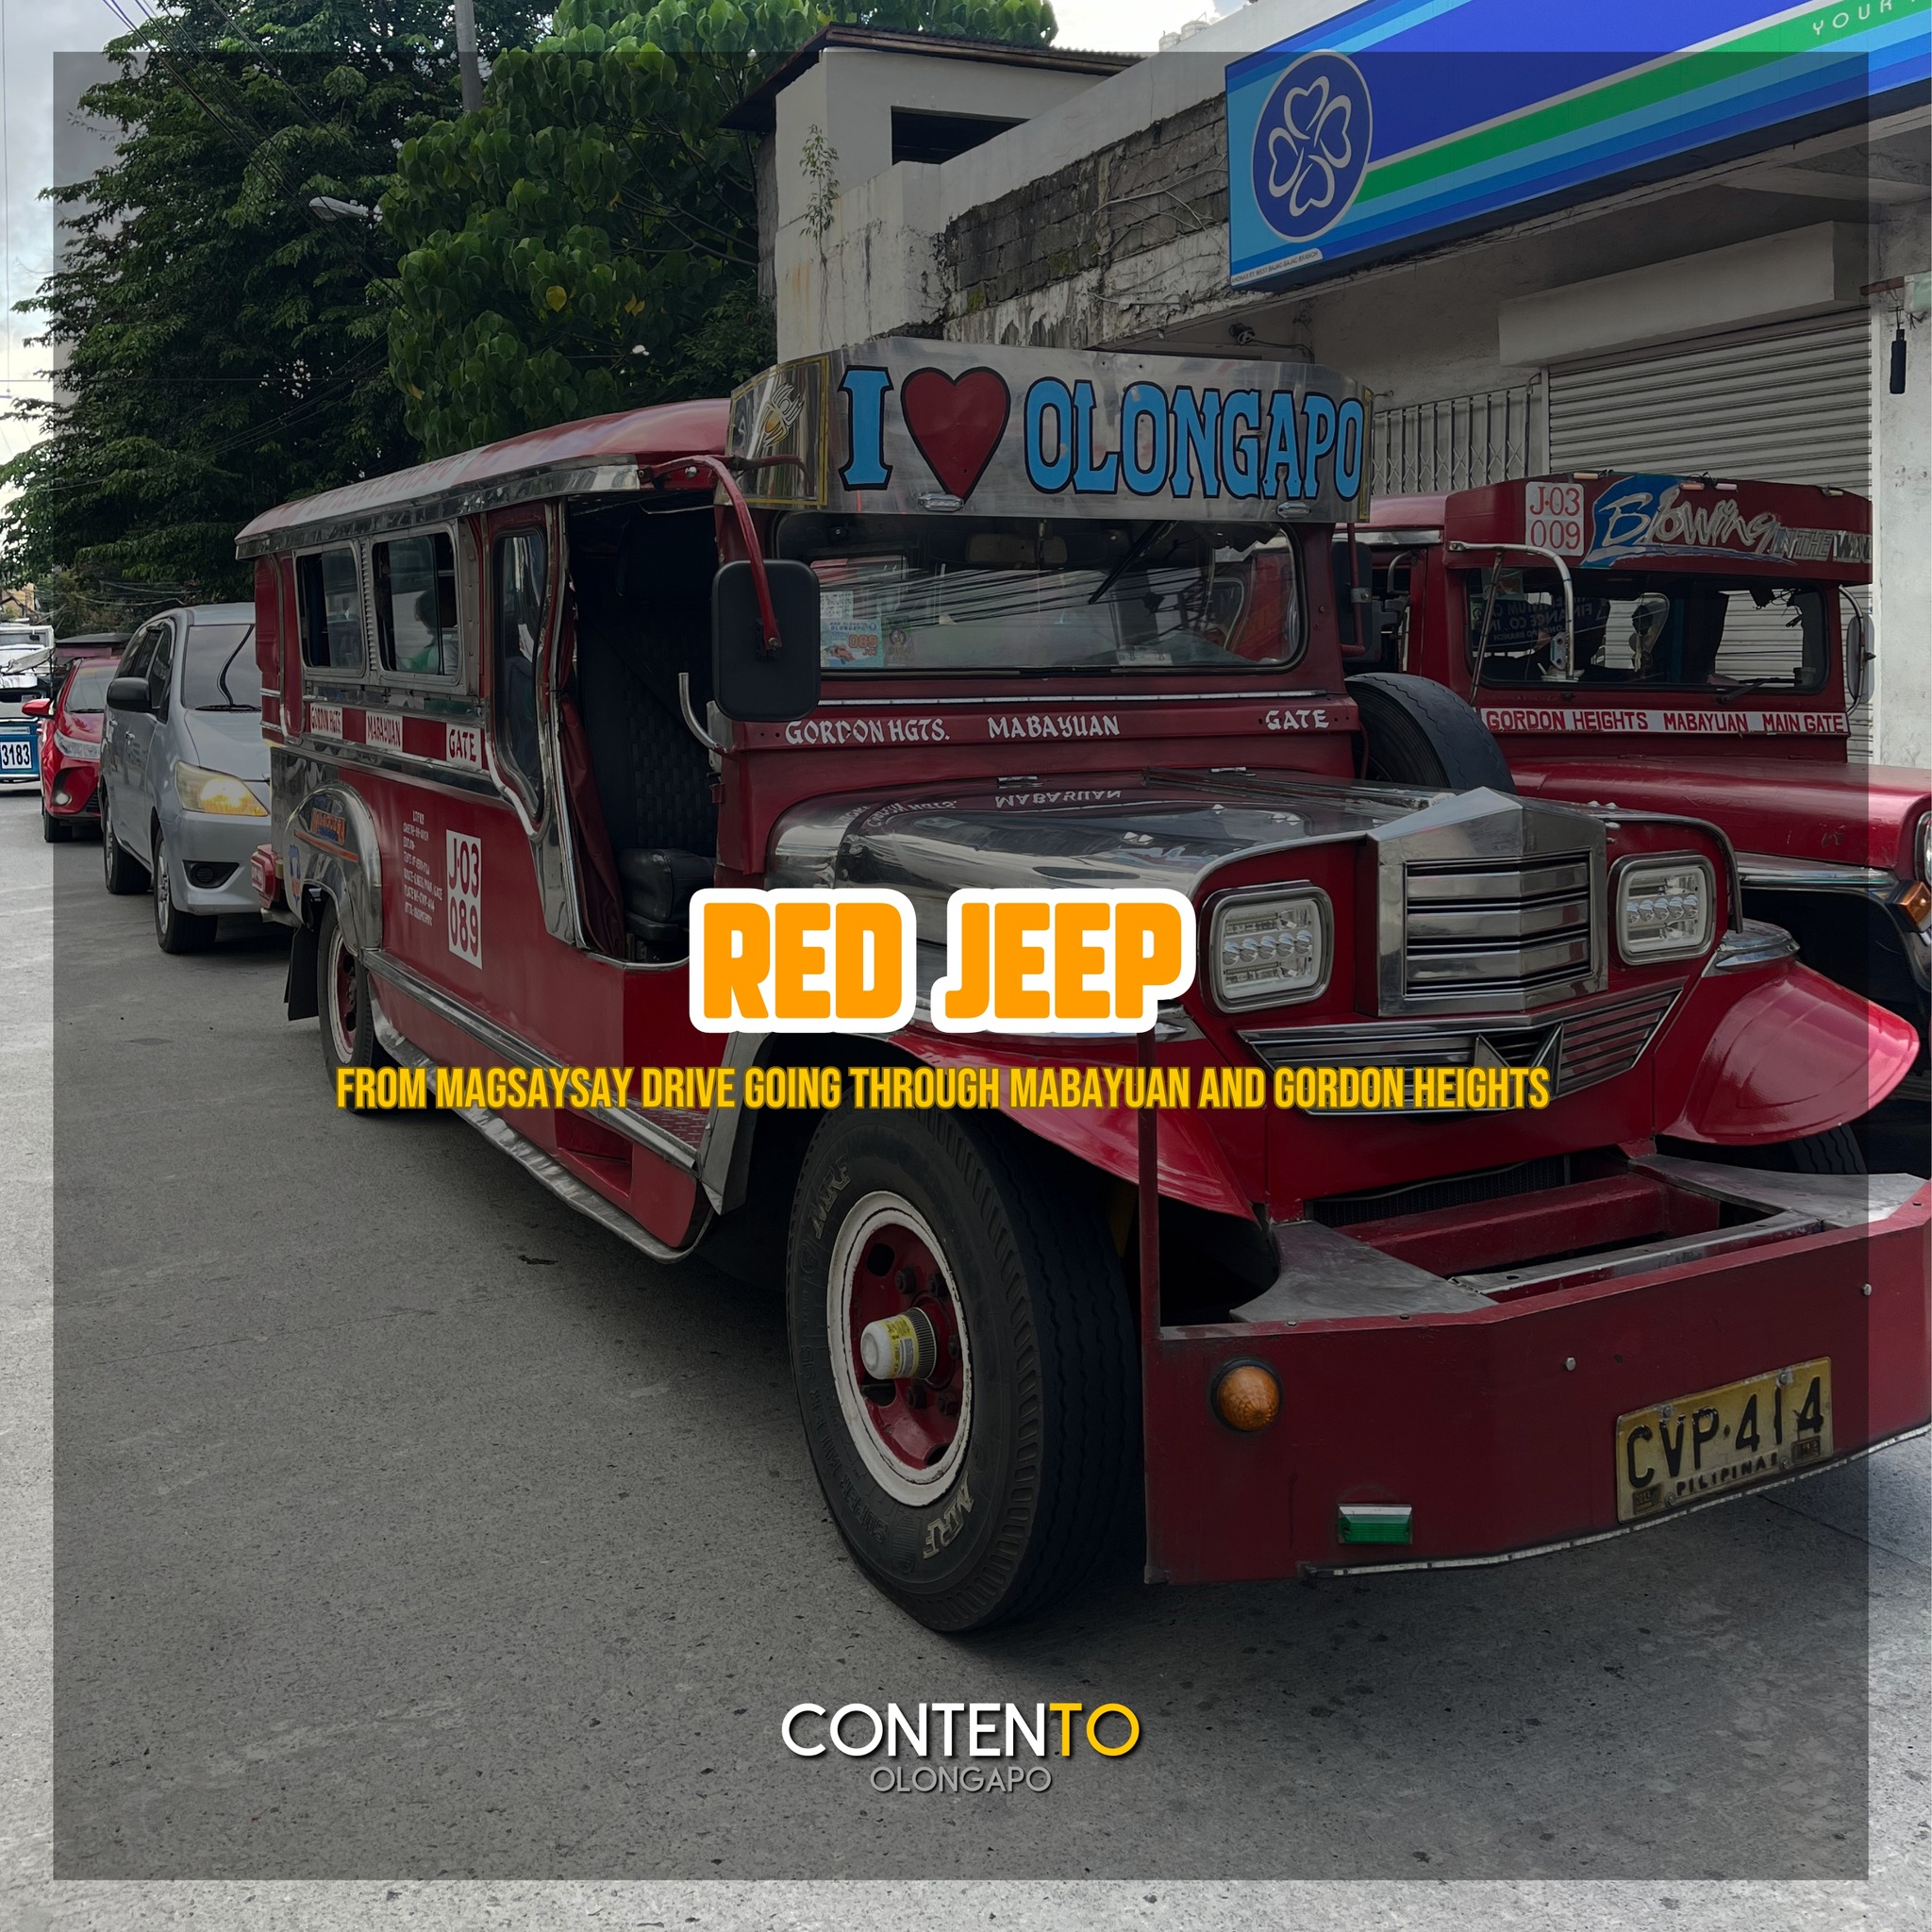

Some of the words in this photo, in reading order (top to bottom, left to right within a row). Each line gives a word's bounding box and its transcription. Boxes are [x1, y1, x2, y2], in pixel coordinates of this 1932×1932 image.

[1812, 0, 1892, 36] YOUR
[1298, 250, 1319, 262] BRANCH
[838, 364, 894, 491] I
[1024, 375, 1365, 503] OLONGAPO
[1530, 520, 1581, 550] 009
[785, 718, 885, 745] GORDON
[889, 717, 951, 741] HGTS.
[987, 713, 1121, 739] MABAYUAN
[1265, 708, 1329, 730] GATE
[1486, 710, 1565, 731] GORDON
[1573, 710, 1649, 731] HEIGHTS
[1663, 712, 1748, 732] MABAYUAN
[1762, 713, 1802, 732] MAIN
[1804, 714, 1843, 733] GATE
[1, 743, 30, 766] 3183
[449, 728, 477, 763] GATE
[448, 897, 479, 958] 089
